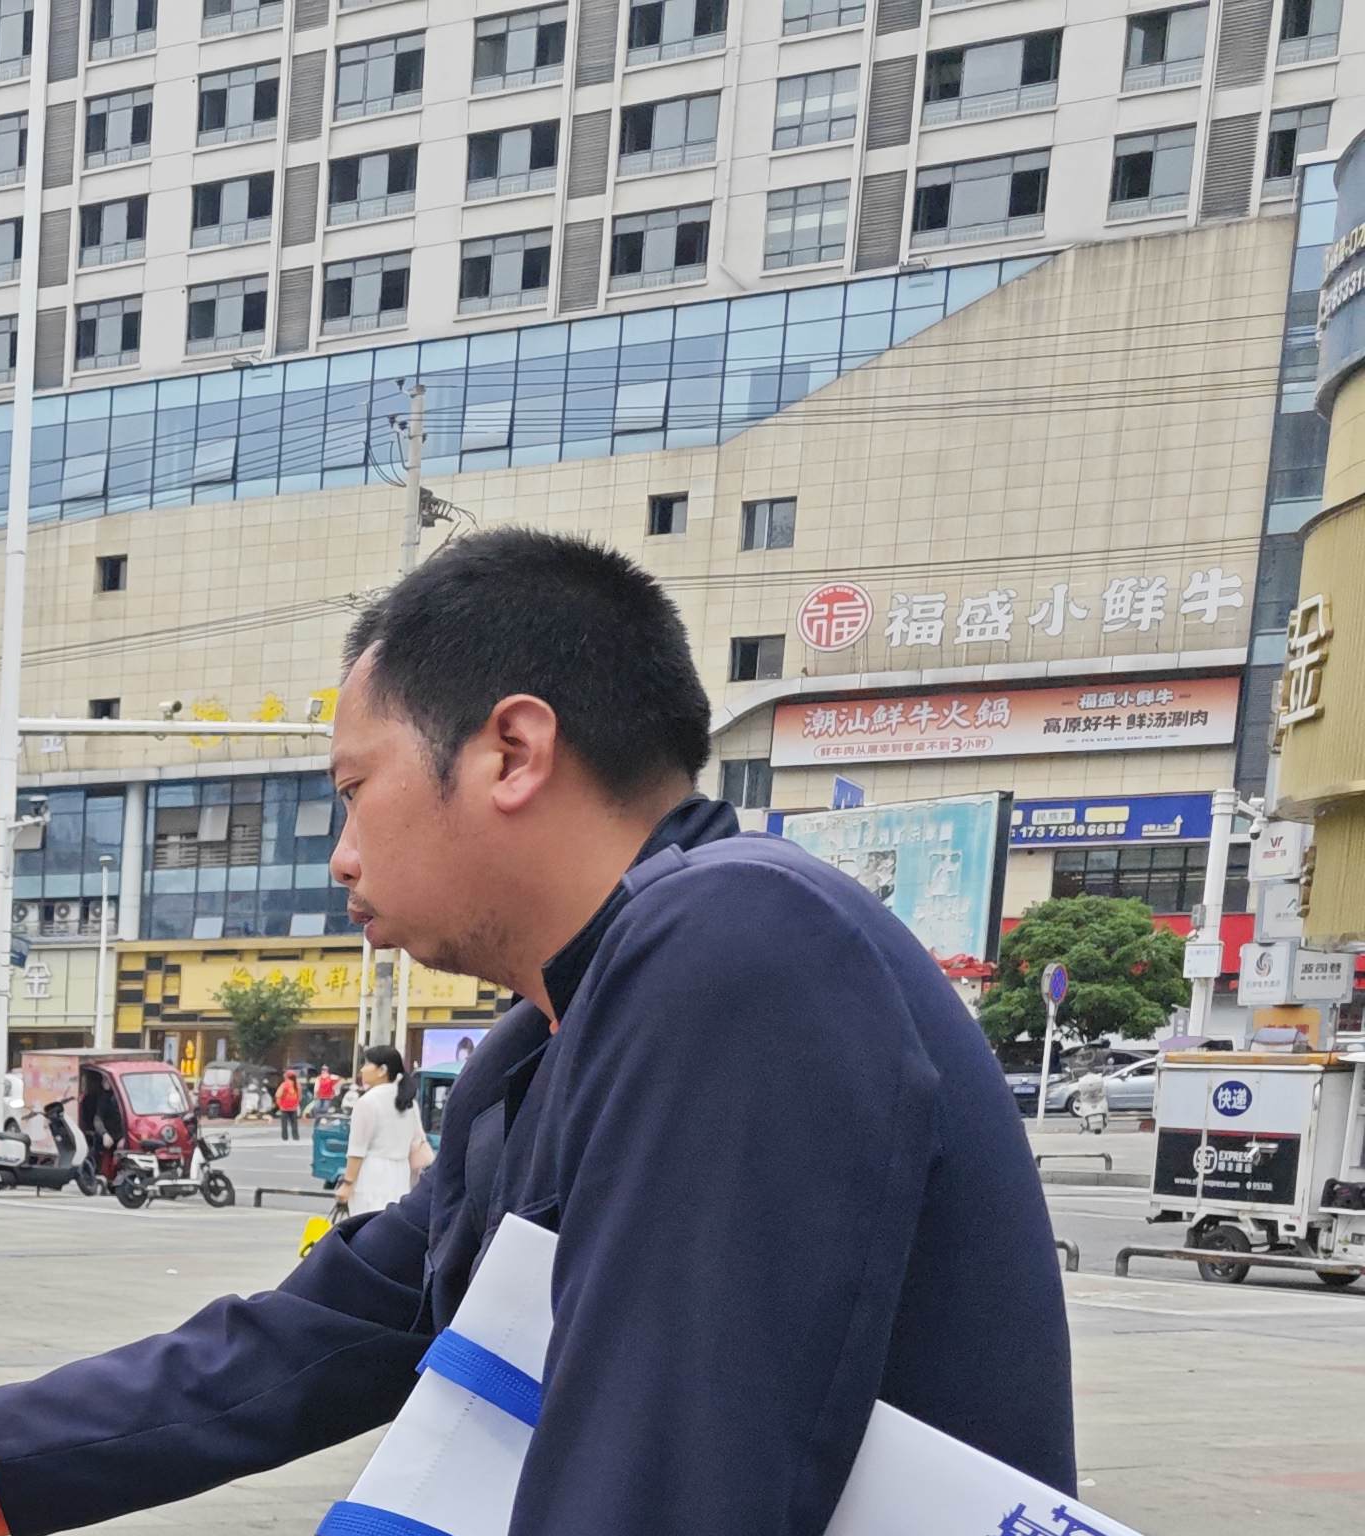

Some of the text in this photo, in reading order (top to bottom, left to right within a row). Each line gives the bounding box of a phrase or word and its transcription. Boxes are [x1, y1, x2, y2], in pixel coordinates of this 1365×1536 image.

[884, 567, 1245, 648] 福盛小鲜牛
[1043, 709, 1209, 735] 高原好牛 鲜汤涮肉
[1217, 1087, 1248, 1110] 快递
